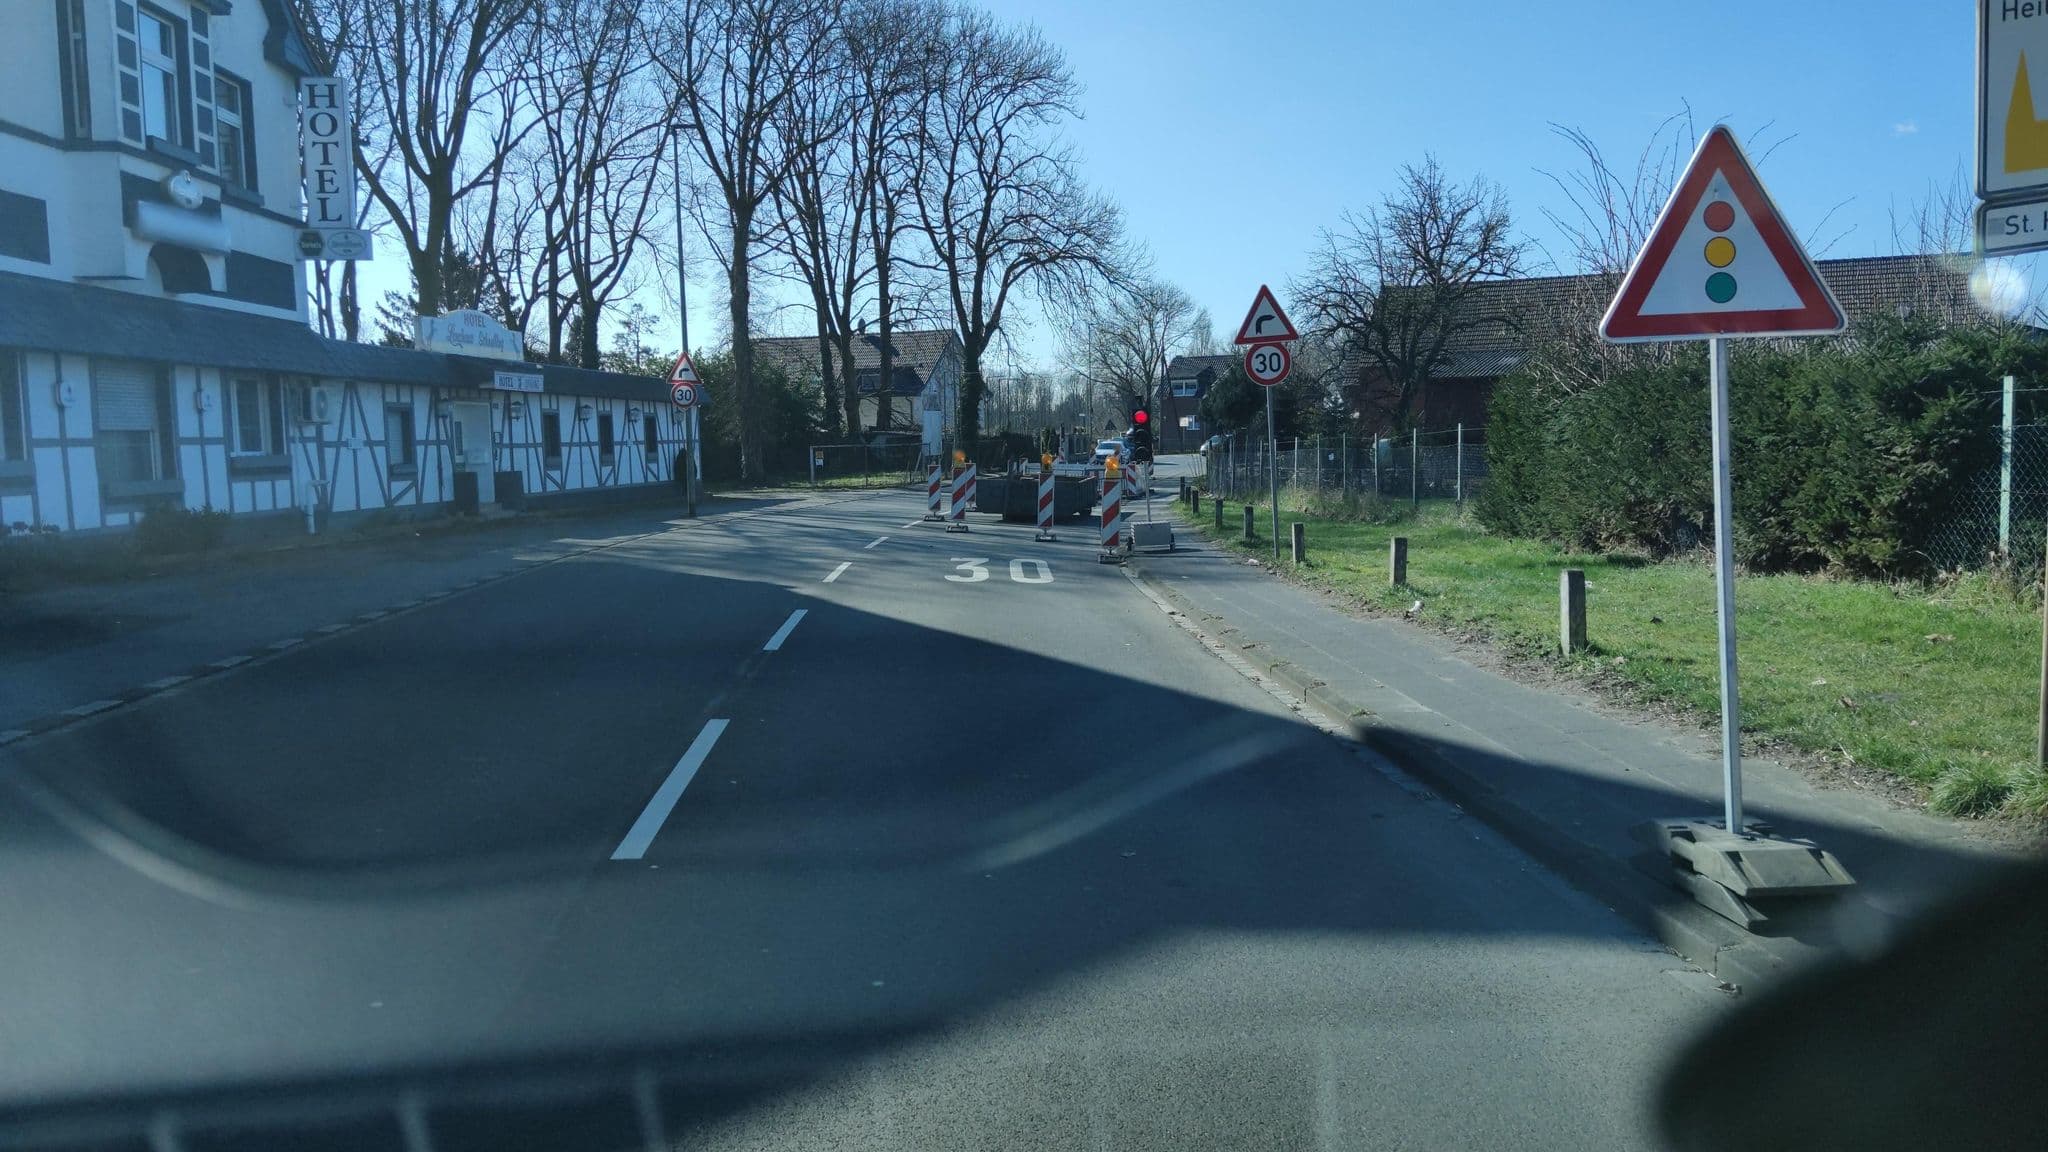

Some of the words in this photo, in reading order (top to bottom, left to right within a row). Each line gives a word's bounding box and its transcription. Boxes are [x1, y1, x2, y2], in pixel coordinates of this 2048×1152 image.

[305, 84, 342, 222] HOTEL
[2005, 214, 2034, 236] St.
[463, 312, 487, 328] HOTEL
[1255, 352, 1281, 373] 30
[677, 389, 692, 401] 30
[943, 557, 1055, 584] 30
